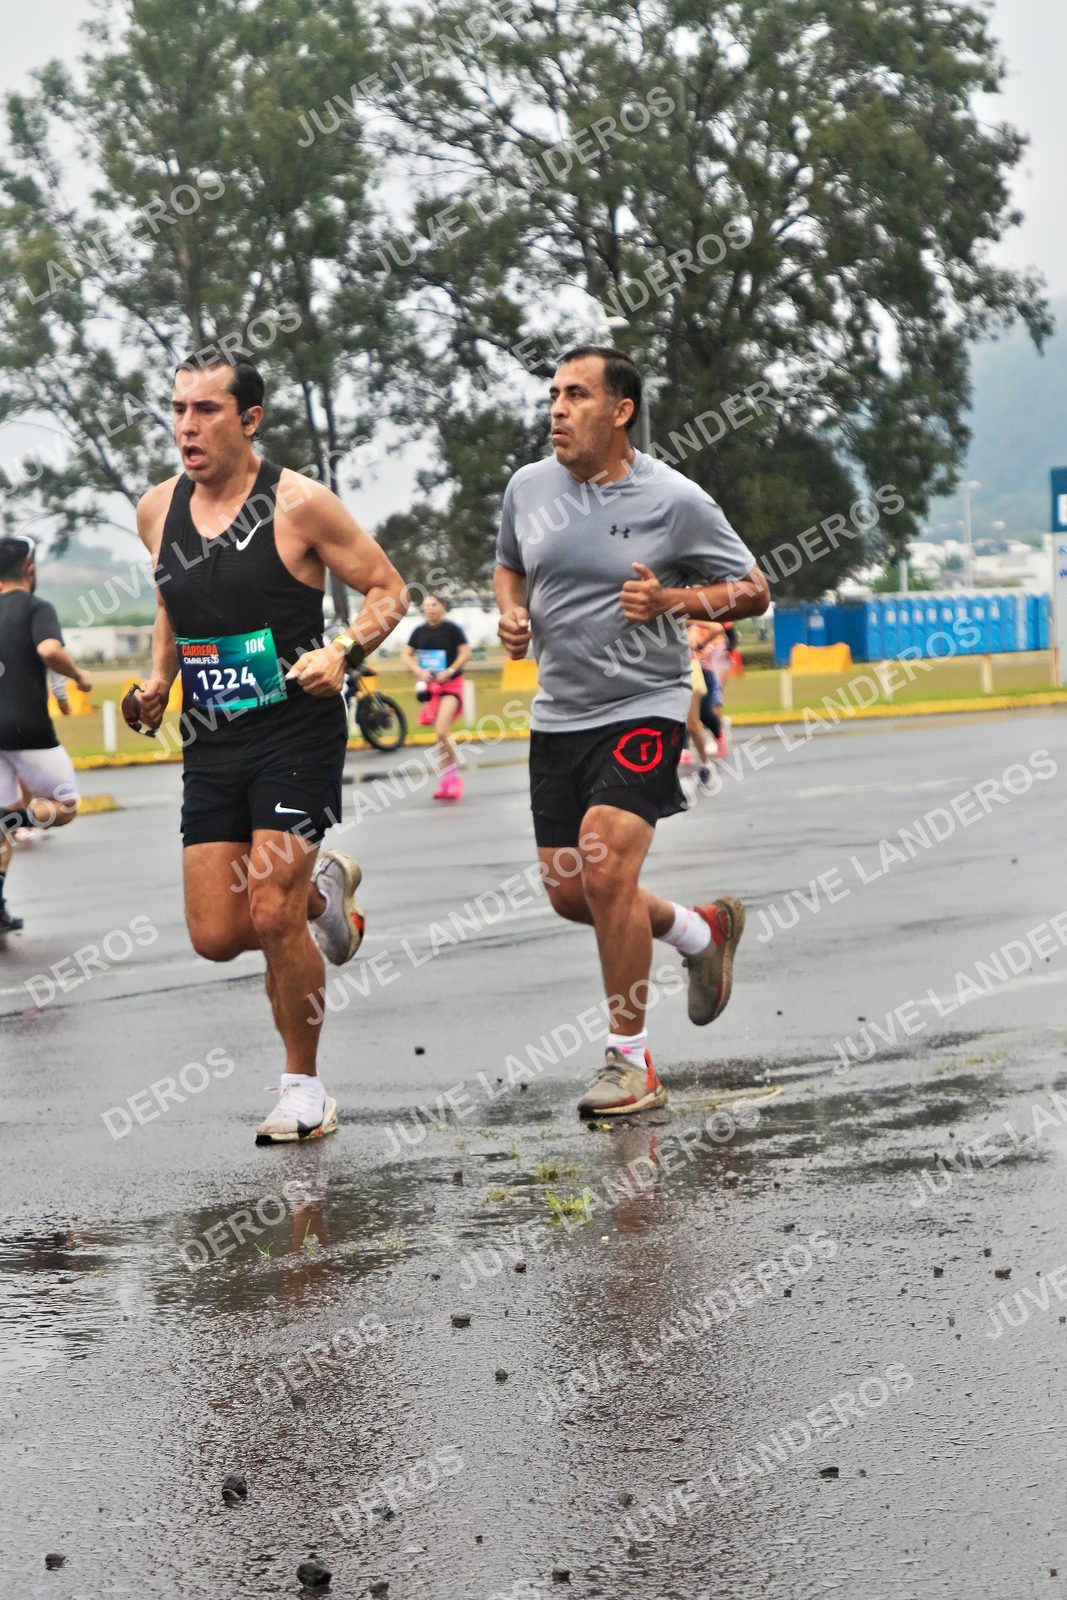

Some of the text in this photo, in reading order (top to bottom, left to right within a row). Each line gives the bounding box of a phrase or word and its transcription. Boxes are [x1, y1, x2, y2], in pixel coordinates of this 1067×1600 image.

[182, 644, 218, 656] CARRERA
[245, 636, 266, 654] 10K
[197, 666, 256, 690] 1224
